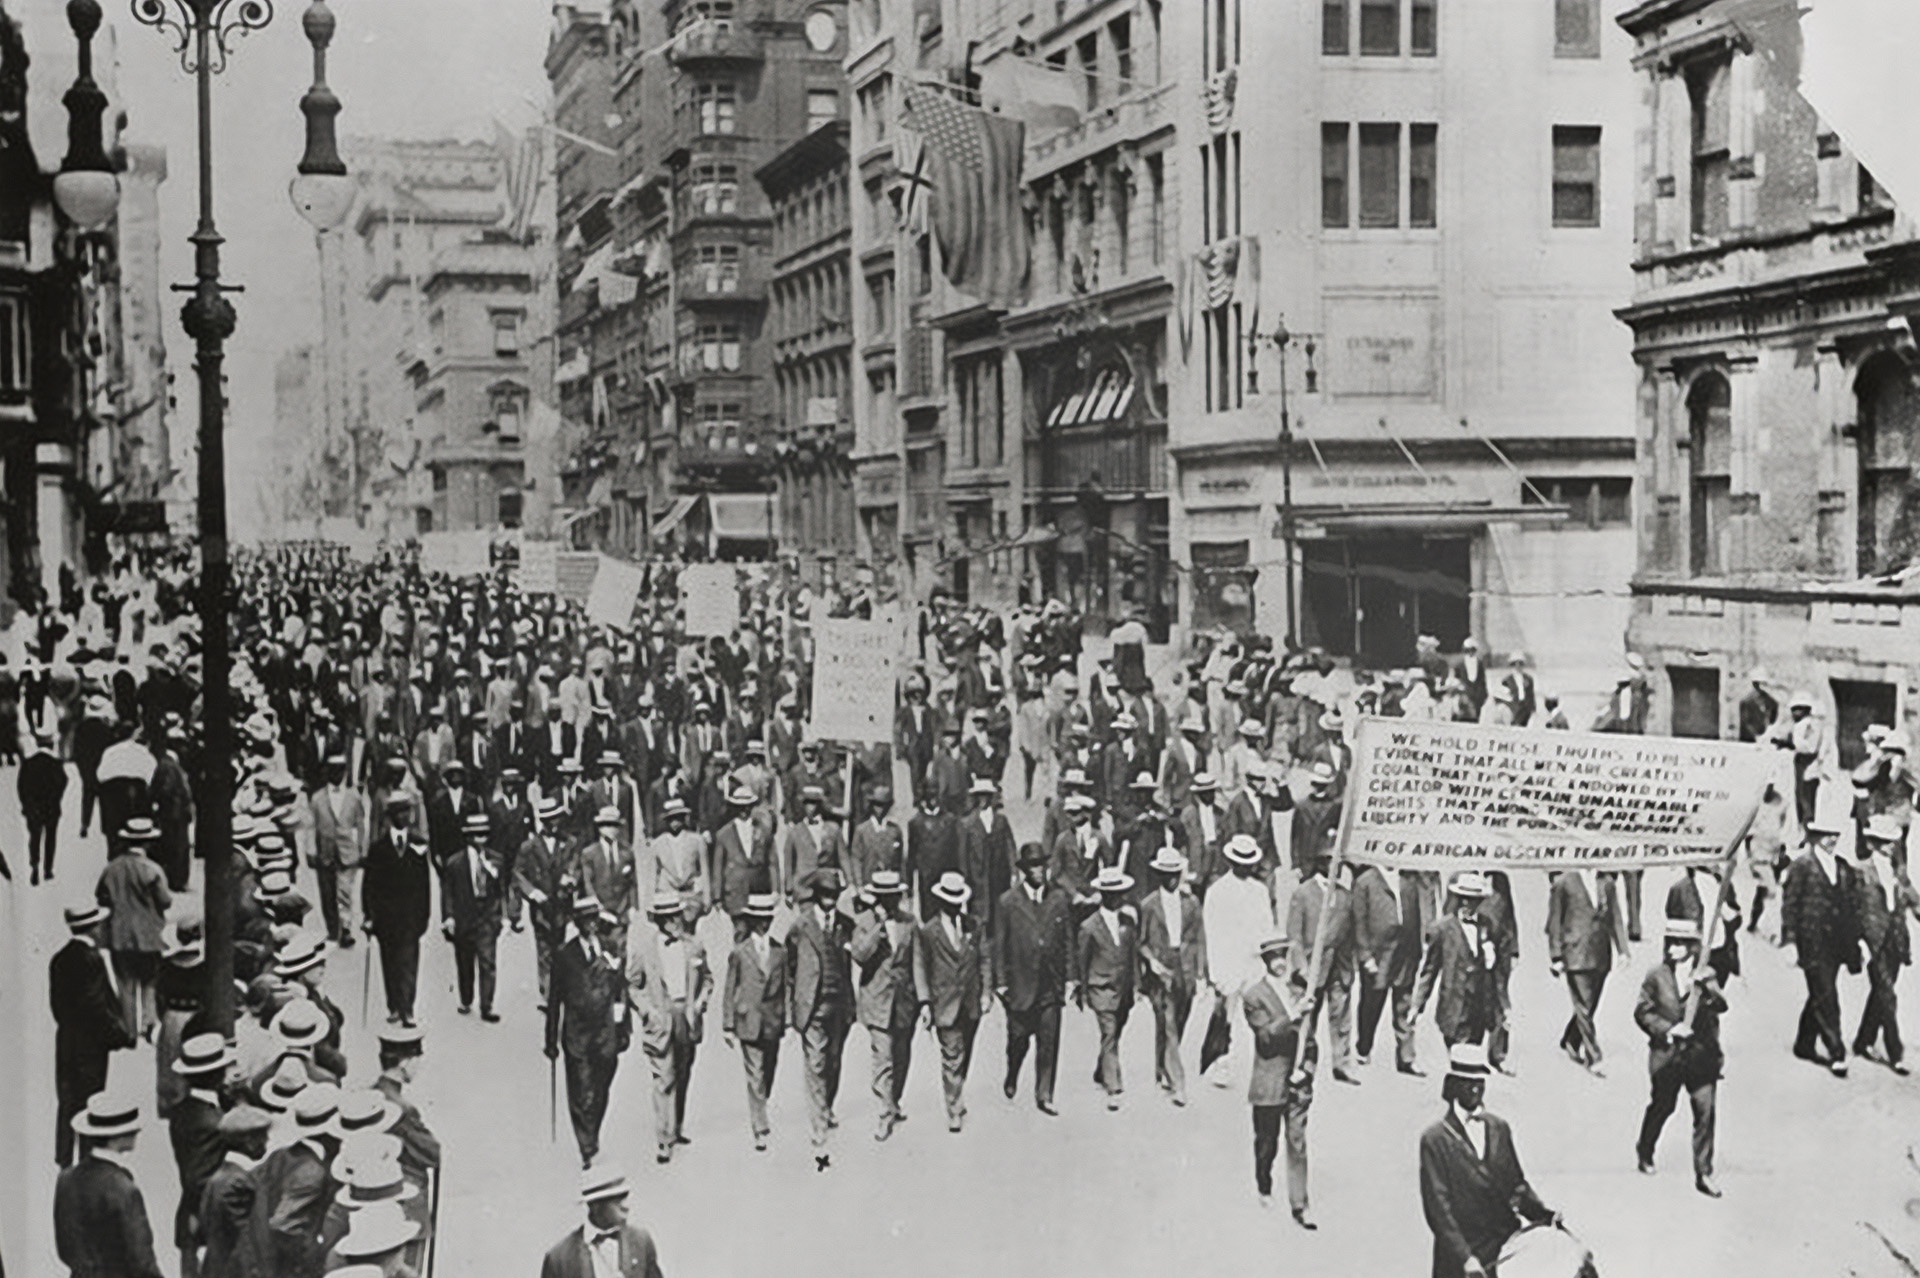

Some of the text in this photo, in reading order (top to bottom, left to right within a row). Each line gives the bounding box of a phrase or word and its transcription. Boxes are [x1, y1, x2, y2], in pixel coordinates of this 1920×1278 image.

[1391, 732, 1421, 746] WE
[1430, 736, 1479, 751] HOLD
[1373, 746, 1444, 764] EVIDENT
[1453, 753, 1495, 767] THAT
[1498, 757, 1527, 771] ALL
[1534, 760, 1567, 773] MEN
[1372, 763, 1421, 777] EQUAL
[1431, 766, 1470, 781] THAT
[1522, 774, 1556, 788] ARE
[1368, 778, 1444, 793] CREATOR
[1448, 782, 1494, 798] WITH
[1366, 795, 1426, 810] RIGHTS
[1436, 796, 1480, 812] THAT
[1602, 810, 1640, 822] ARE
[1360, 810, 1430, 826] LIBERTY
[1438, 812, 1476, 826] AND
[1482, 815, 1510, 828] THE
[1364, 839, 1381, 852] IF
[1384, 841, 1408, 855] OF
[1412, 842, 1488, 858] AFRICAN
